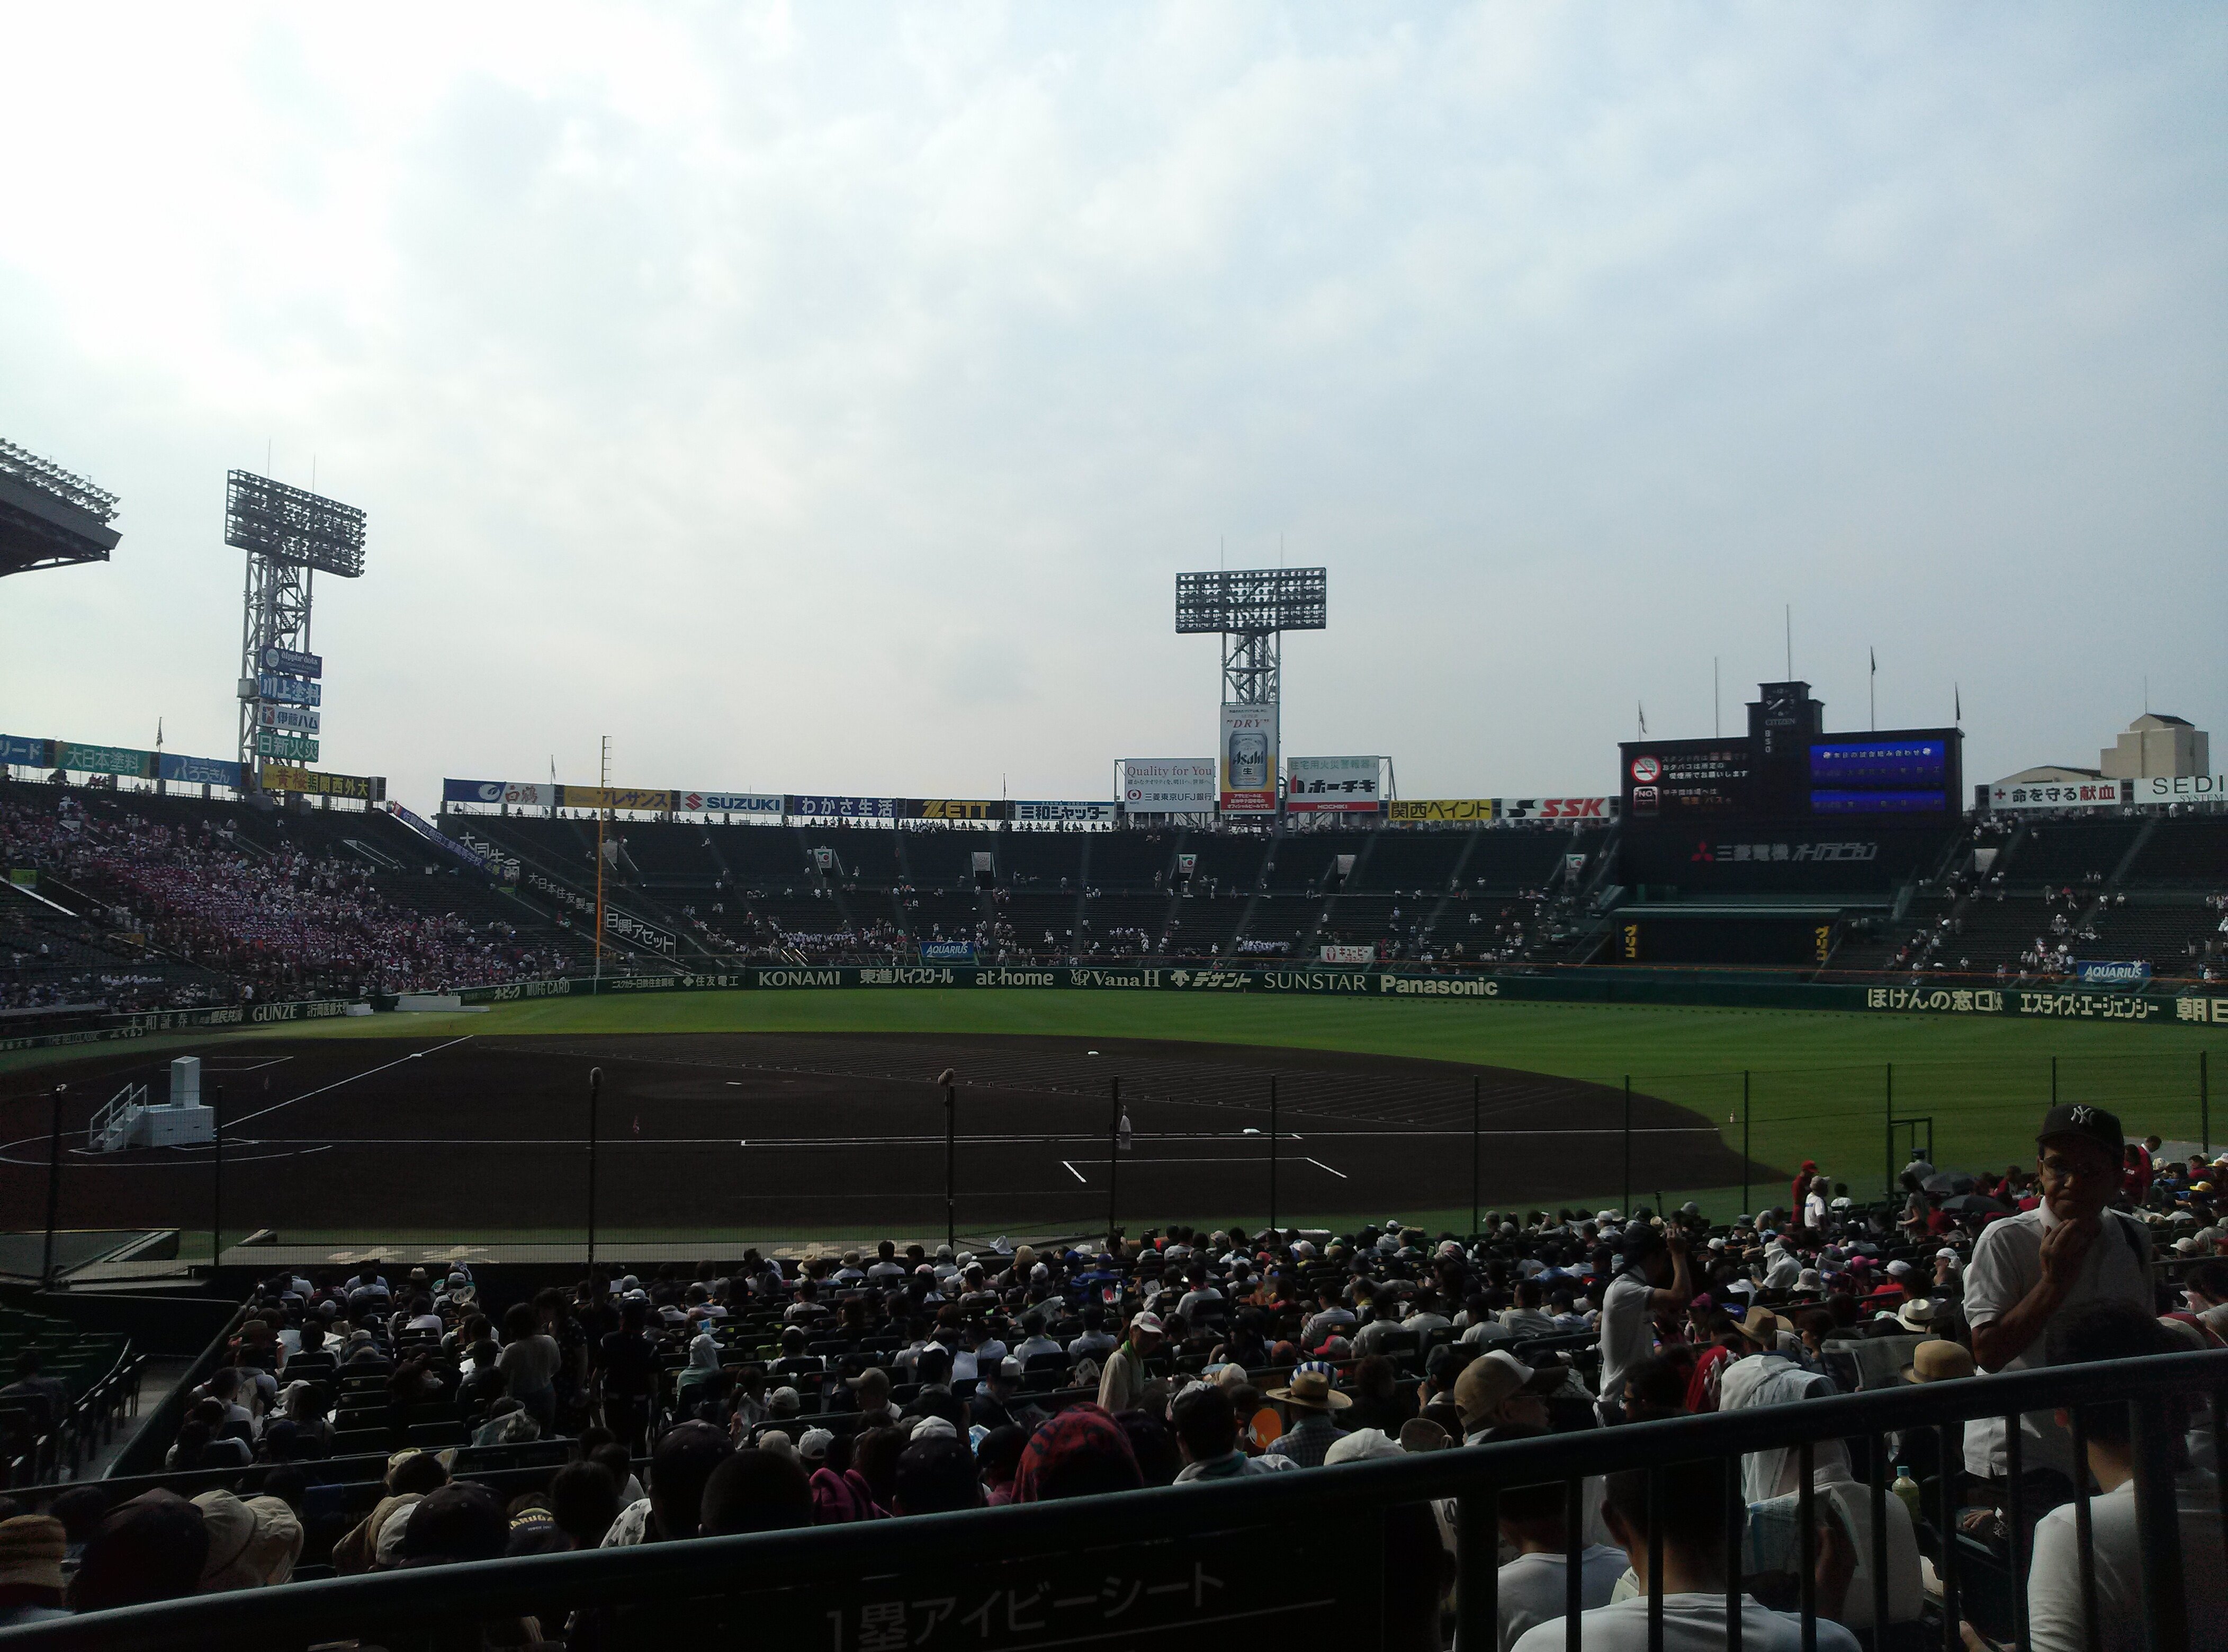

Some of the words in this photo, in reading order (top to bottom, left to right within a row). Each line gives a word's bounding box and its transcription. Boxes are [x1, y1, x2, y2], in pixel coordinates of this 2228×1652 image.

[277, 711, 318, 730] 伊藤ハム
[259, 735, 318, 759] 日新火災
[67, 747, 139, 773] 大日本塗料
[1233, 751, 1264, 765] Asahi
[188, 765, 230, 784] ろうきん
[1127, 766, 1169, 778] Quality
[1173, 766, 1189, 776] for
[1191, 766, 1212, 776] You
[320, 775, 369, 796] 関西外大
[1308, 779, 1376, 793] ホーチキ
[2011, 785, 2116, 803] 命を守る献血
[706, 796, 780, 811] SUZUKI
[1145, 793, 1212, 801] 三菱東京UFJ銀行
[802, 797, 893, 818] わかさ生活
[922, 800, 991, 819] ZETT
[1021, 805, 1109, 820] 三和シャッター
[1391, 800, 1491, 819] 関西ペイント
[1540, 798, 1606, 818] SSK
[529, 873, 596, 914] 大日本住友製薬
[606, 912, 674, 953] 日興アセット
[1624, 924, 1638, 958] グリコ
[926, 942, 968, 956] AQUARIUS
[1339, 946, 1368, 957] キューピー
[1815, 925, 1830, 962] グリコ
[759, 971, 841, 986] KONAMI
[860, 968, 954, 984] 東進ハイスクール
[976, 971, 995, 985] at
[998, 967, 1054, 986] home
[1192, 972, 1251, 987] デサント
[2084, 961, 2143, 980] AQUARIUS
[526, 982, 546, 996] MUFG
[547, 981, 570, 995] CARD
[696, 975, 739, 987] 住友電工
[1264, 972, 1366, 991] SUNSTAR
[1380, 974, 1498, 996] Panasonic
[494, 985, 521, 1001] オービック
[1867, 987, 1996, 1012] ほけんの窓口
[252, 1005, 298, 1022] GUNZE
[2020, 993, 2159, 1019] エスライズ・エージェンシー
[2176, 997, 2228, 1023] 朝日
[128, 1012, 188, 1032] 大和証券
[826, 1561, 1225, 1652] 1塁アイビーシート
